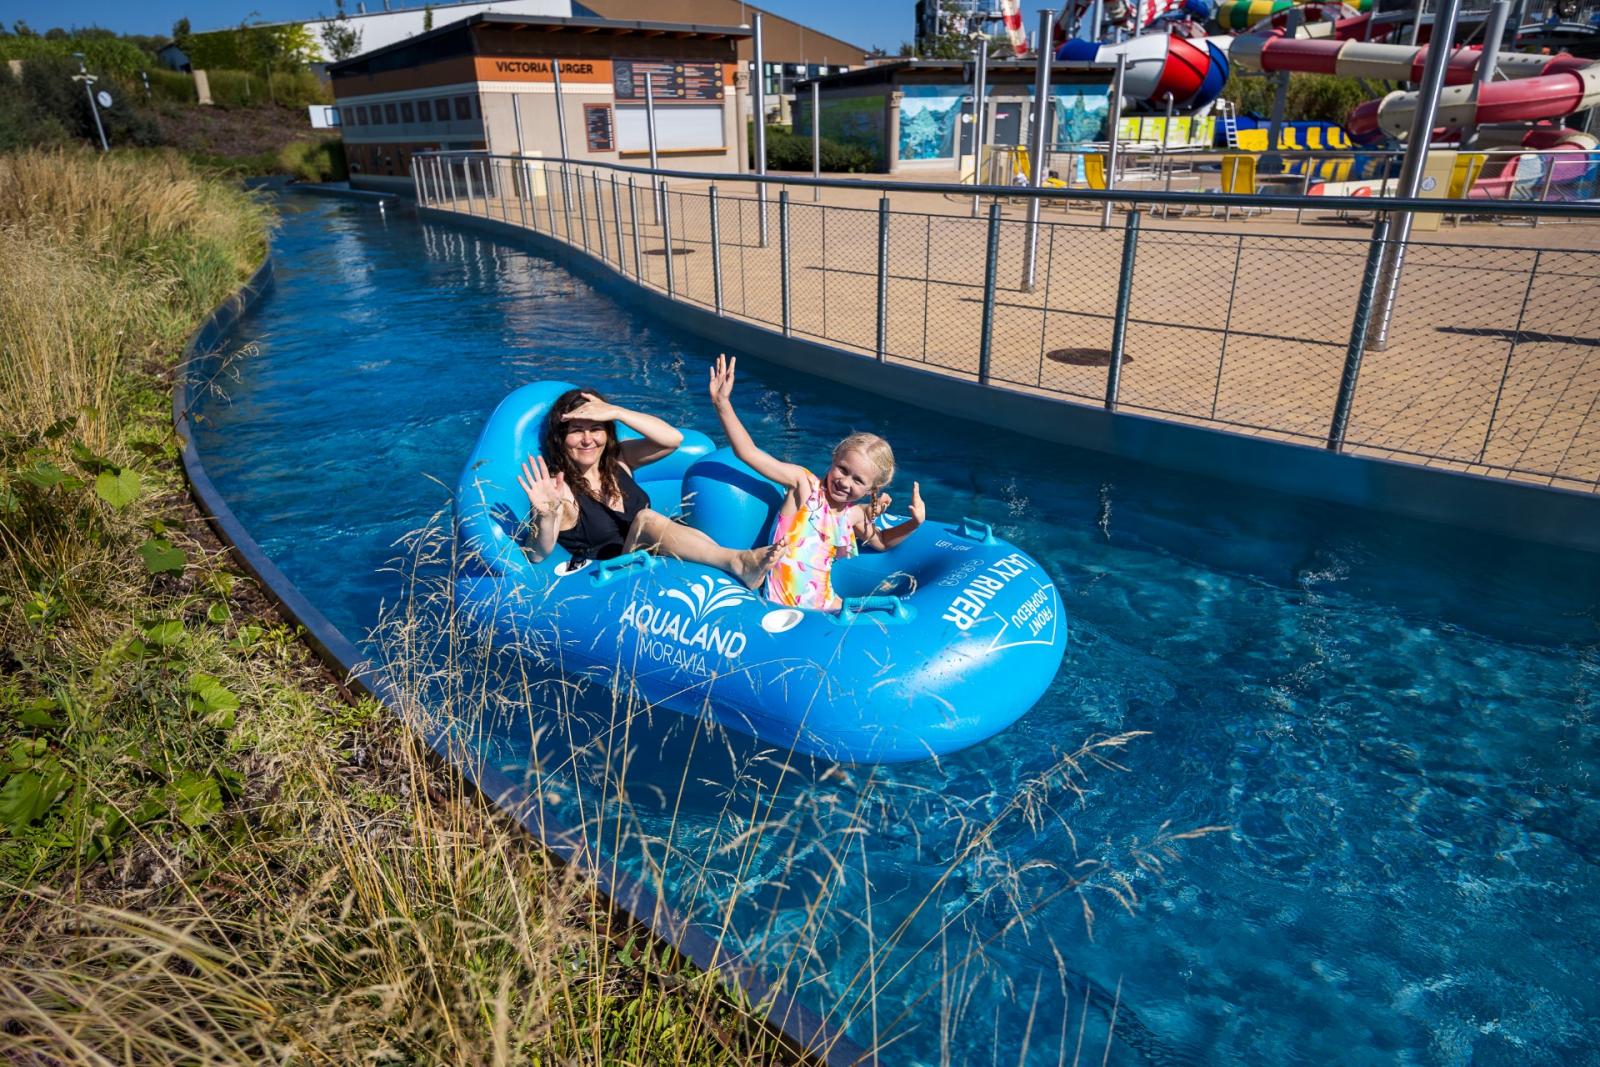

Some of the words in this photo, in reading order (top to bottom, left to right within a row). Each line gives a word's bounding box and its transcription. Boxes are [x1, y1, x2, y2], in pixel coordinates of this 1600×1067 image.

[495, 61, 548, 73] VICTORIA
[550, 63, 593, 75] URGER
[986, 552, 1036, 582] LAZY
[942, 574, 1005, 631] RIVER
[1011, 588, 1049, 629] DOPŘEDU
[1028, 605, 1054, 637] FRONT
[619, 600, 747, 659] AQUALAND
[638, 636, 708, 677] MORAVIA
